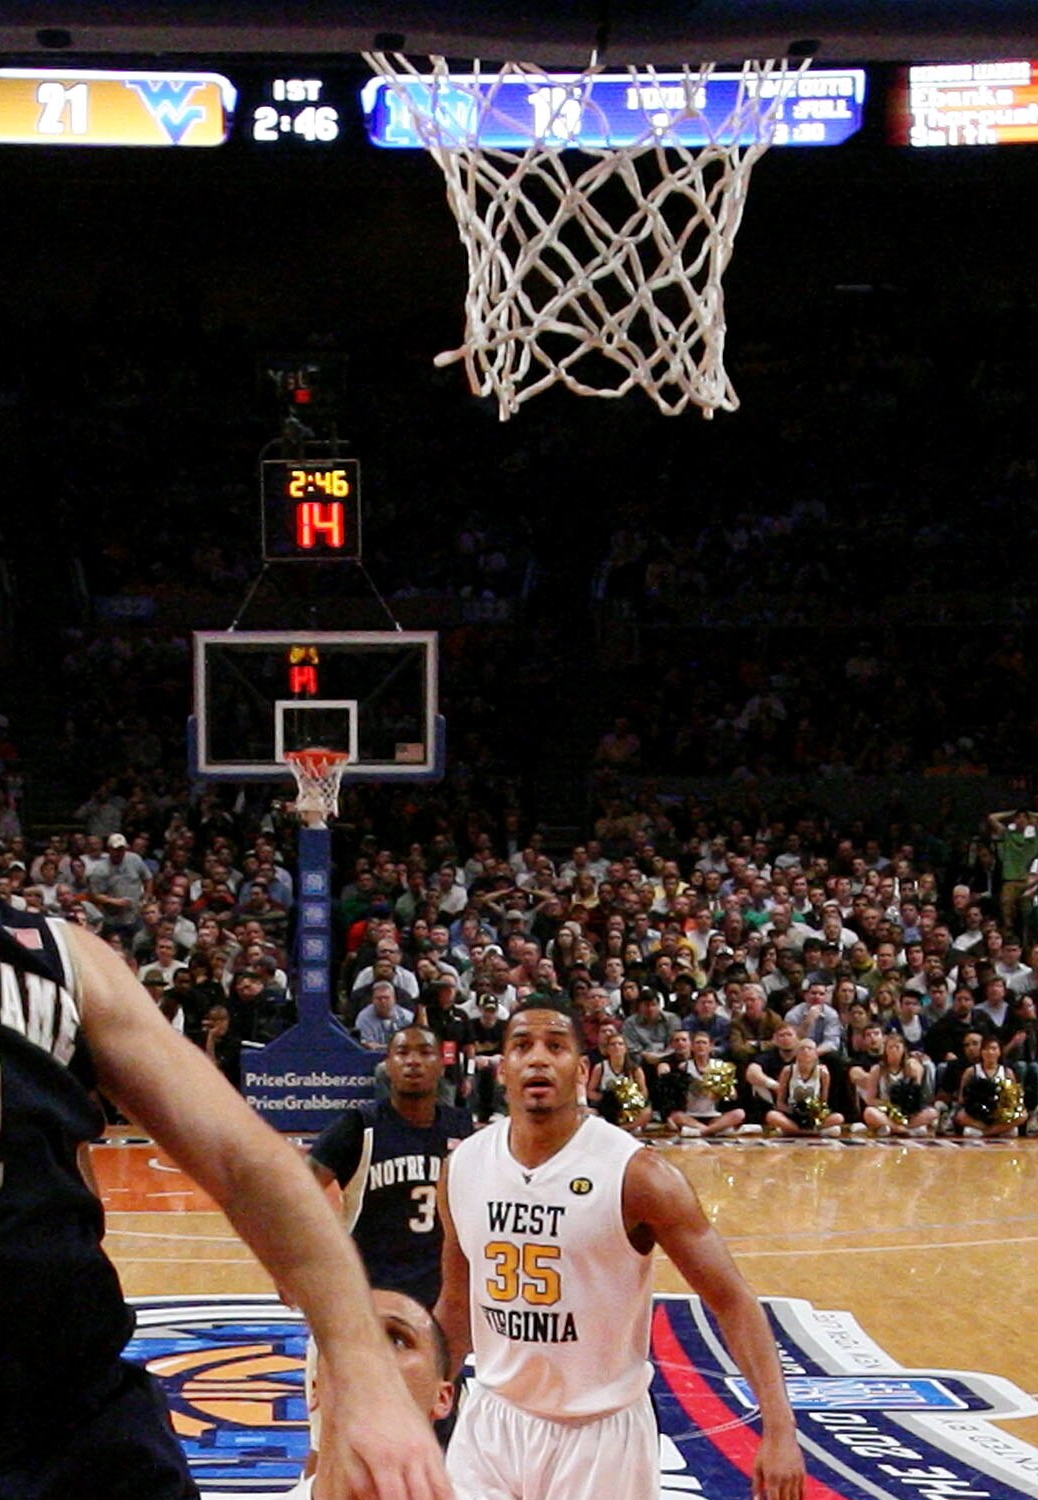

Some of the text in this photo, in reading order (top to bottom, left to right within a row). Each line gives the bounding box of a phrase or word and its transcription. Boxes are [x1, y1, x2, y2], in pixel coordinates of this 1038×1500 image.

[36, 82, 89, 134] 21
[254, 107, 339, 141] 2:46
[910, 125, 997, 147] Smith
[289, 470, 349, 497] 2:46
[296, 502, 345, 548] 14
[370, 1155, 425, 1191] NOTRE
[487, 1201, 566, 1237] WEST
[484, 1240, 562, 1307] 35
